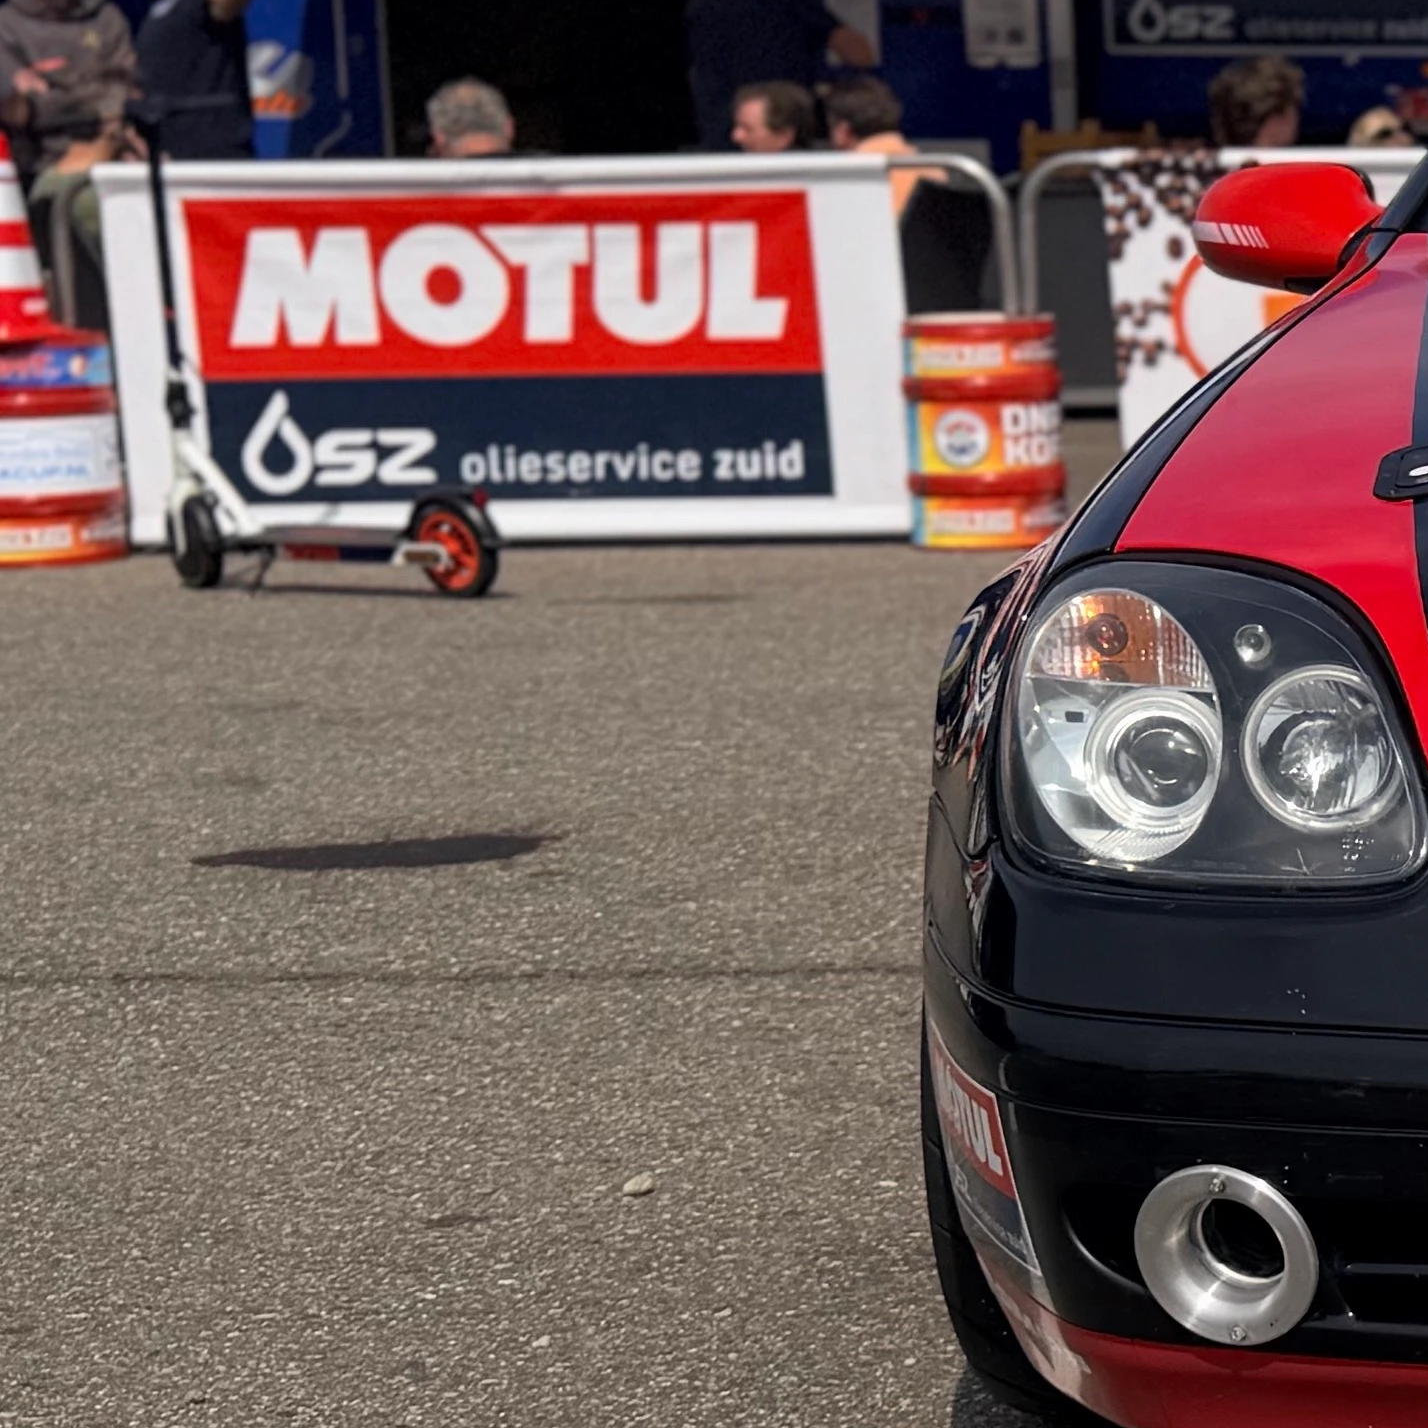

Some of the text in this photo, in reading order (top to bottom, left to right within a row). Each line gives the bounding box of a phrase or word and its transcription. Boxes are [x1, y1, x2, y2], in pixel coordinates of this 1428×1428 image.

[229, 221, 790, 348] MOTUL
[461, 444, 702, 485] olieservice
[713, 438, 806, 481] zuid
